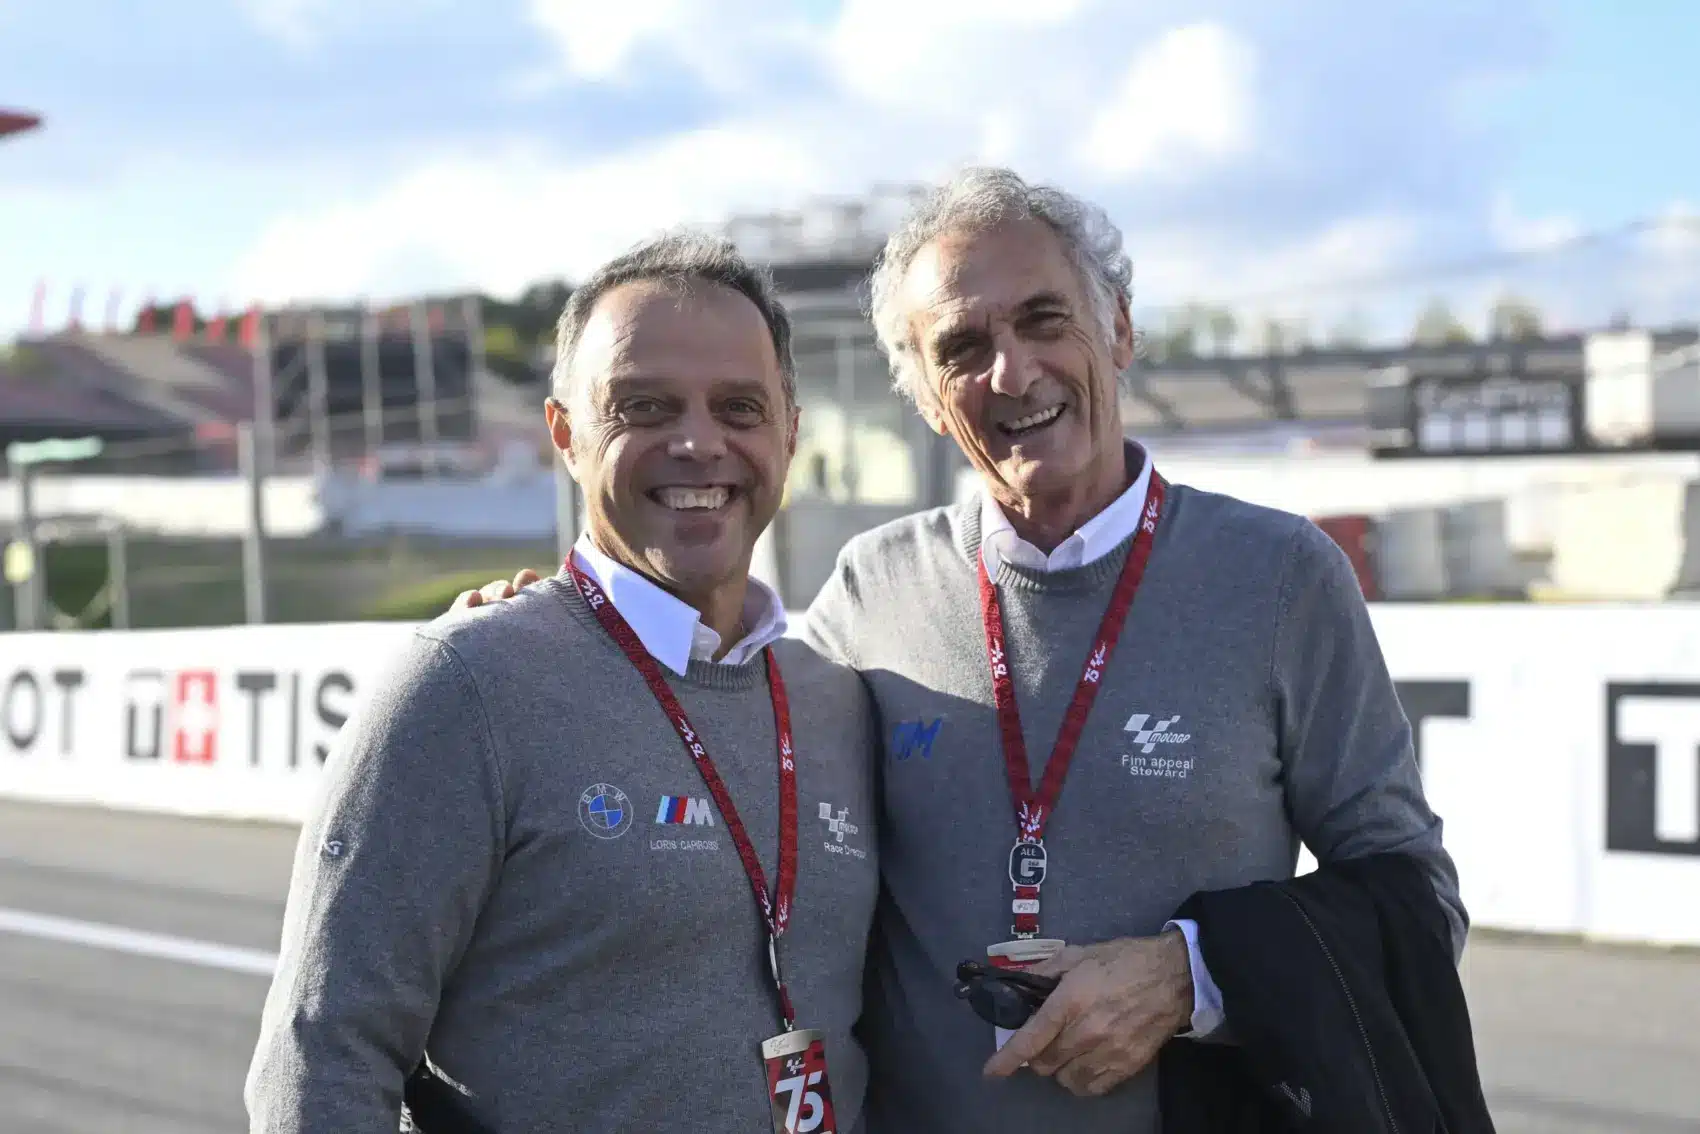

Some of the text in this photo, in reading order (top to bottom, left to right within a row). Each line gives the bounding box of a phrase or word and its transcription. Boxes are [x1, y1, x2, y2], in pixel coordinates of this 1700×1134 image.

[1151, 757, 1195, 770] appeal
[1130, 766, 1188, 778] Steward
[774, 1070, 825, 1134] 75
